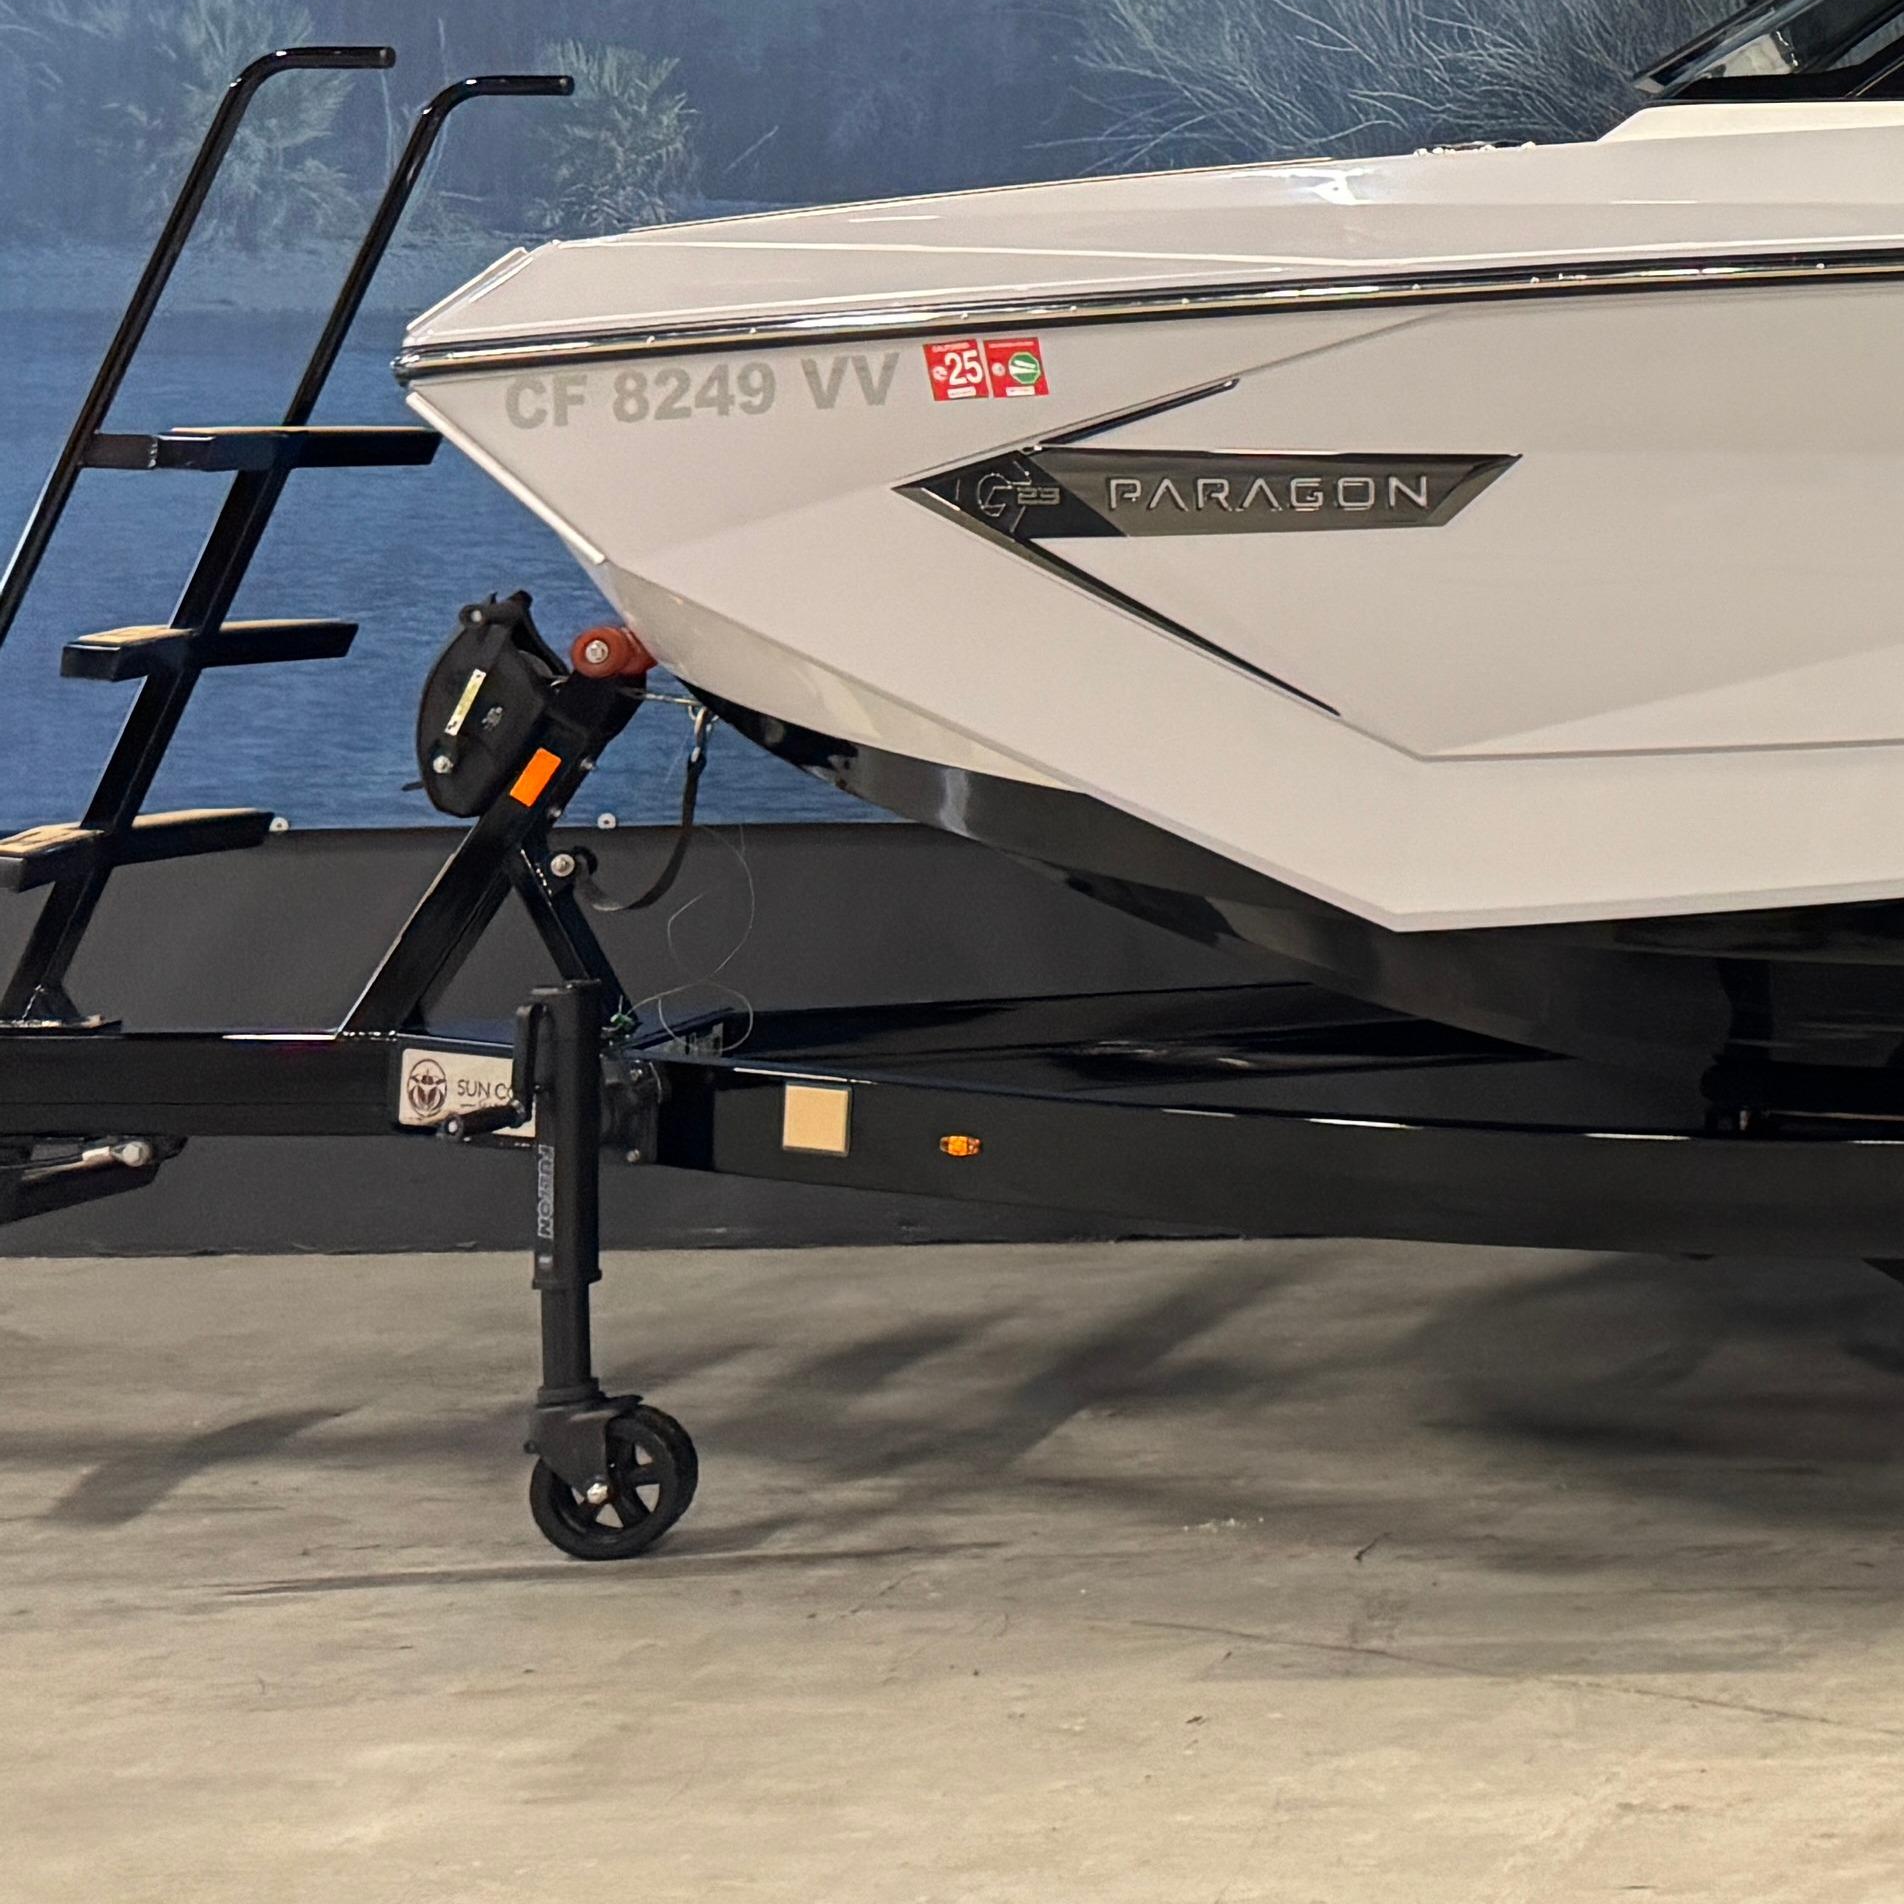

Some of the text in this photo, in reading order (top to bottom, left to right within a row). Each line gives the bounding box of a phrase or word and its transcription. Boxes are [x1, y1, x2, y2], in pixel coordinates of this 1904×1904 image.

[944, 350, 984, 386] 25
[505, 352, 900, 430] CF 8249 VV
[1109, 474, 1429, 512] PARAGON
[457, 1079, 491, 1099] SUN
